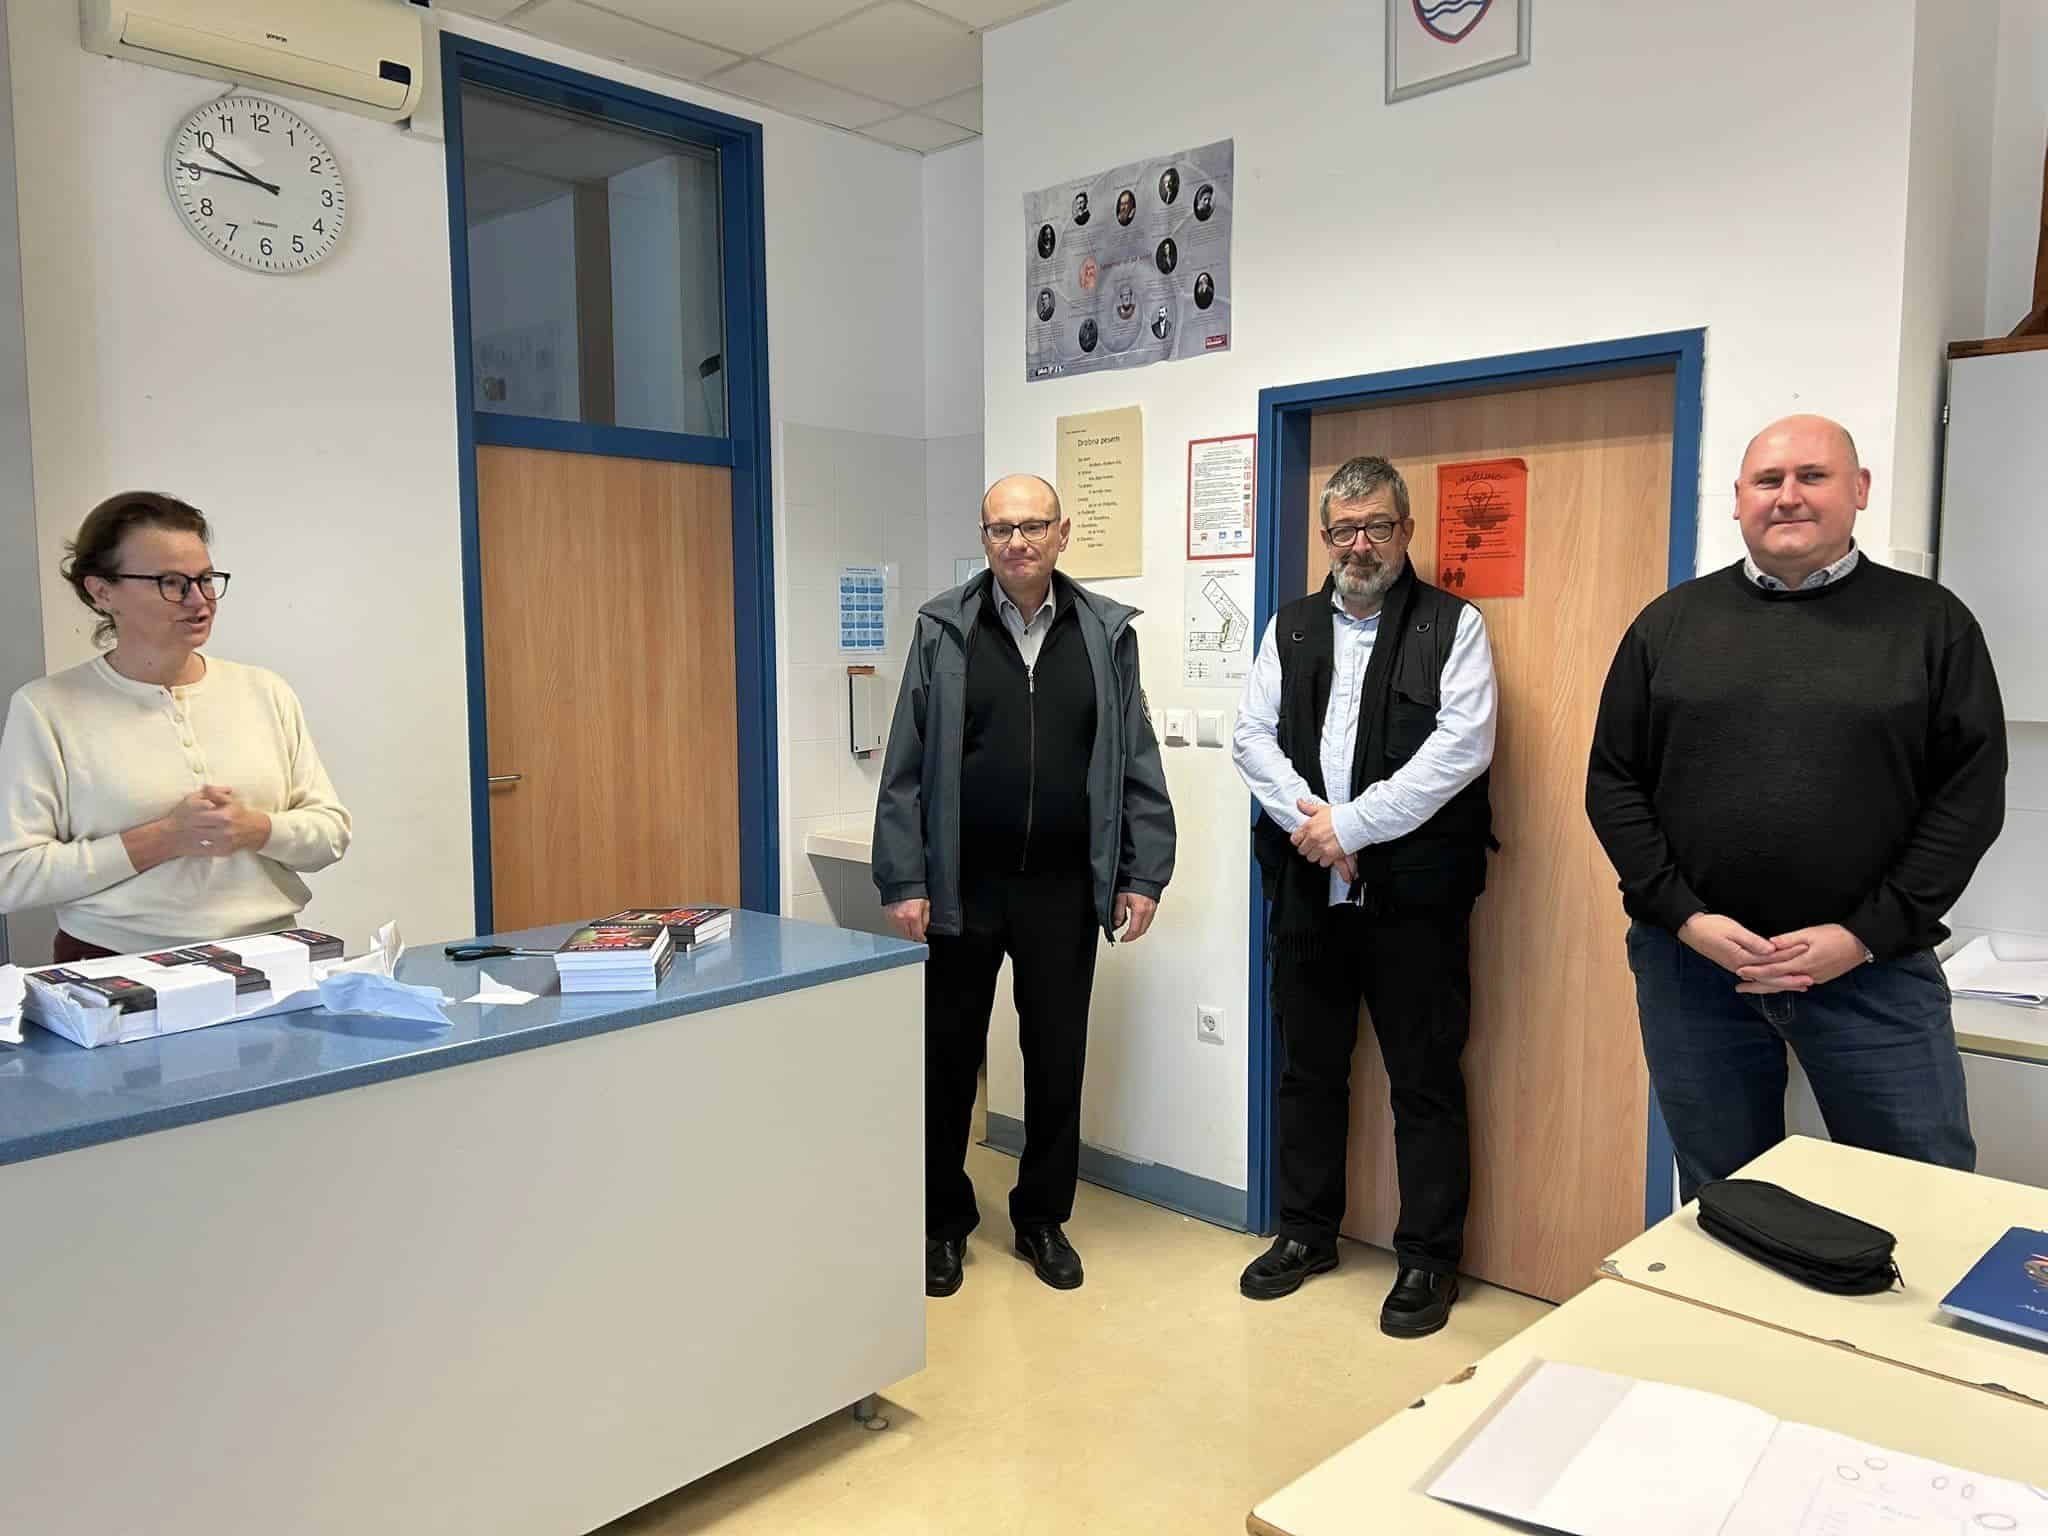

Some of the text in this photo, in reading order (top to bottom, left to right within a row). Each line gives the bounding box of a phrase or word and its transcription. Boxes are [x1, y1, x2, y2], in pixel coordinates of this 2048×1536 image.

[218, 114, 234, 135] 11
[250, 113, 271, 134] 12
[194, 131, 214, 150] 10
[286, 130, 295, 147] 1
[188, 162, 201, 181] 9
[310, 156, 322, 175] 2
[200, 198, 214, 217] 8
[321, 190, 334, 208] 3
[226, 223, 239, 241] 7
[312, 218, 325, 235] 4
[260, 237, 273, 256] 6
[292, 235, 304, 253] 5
